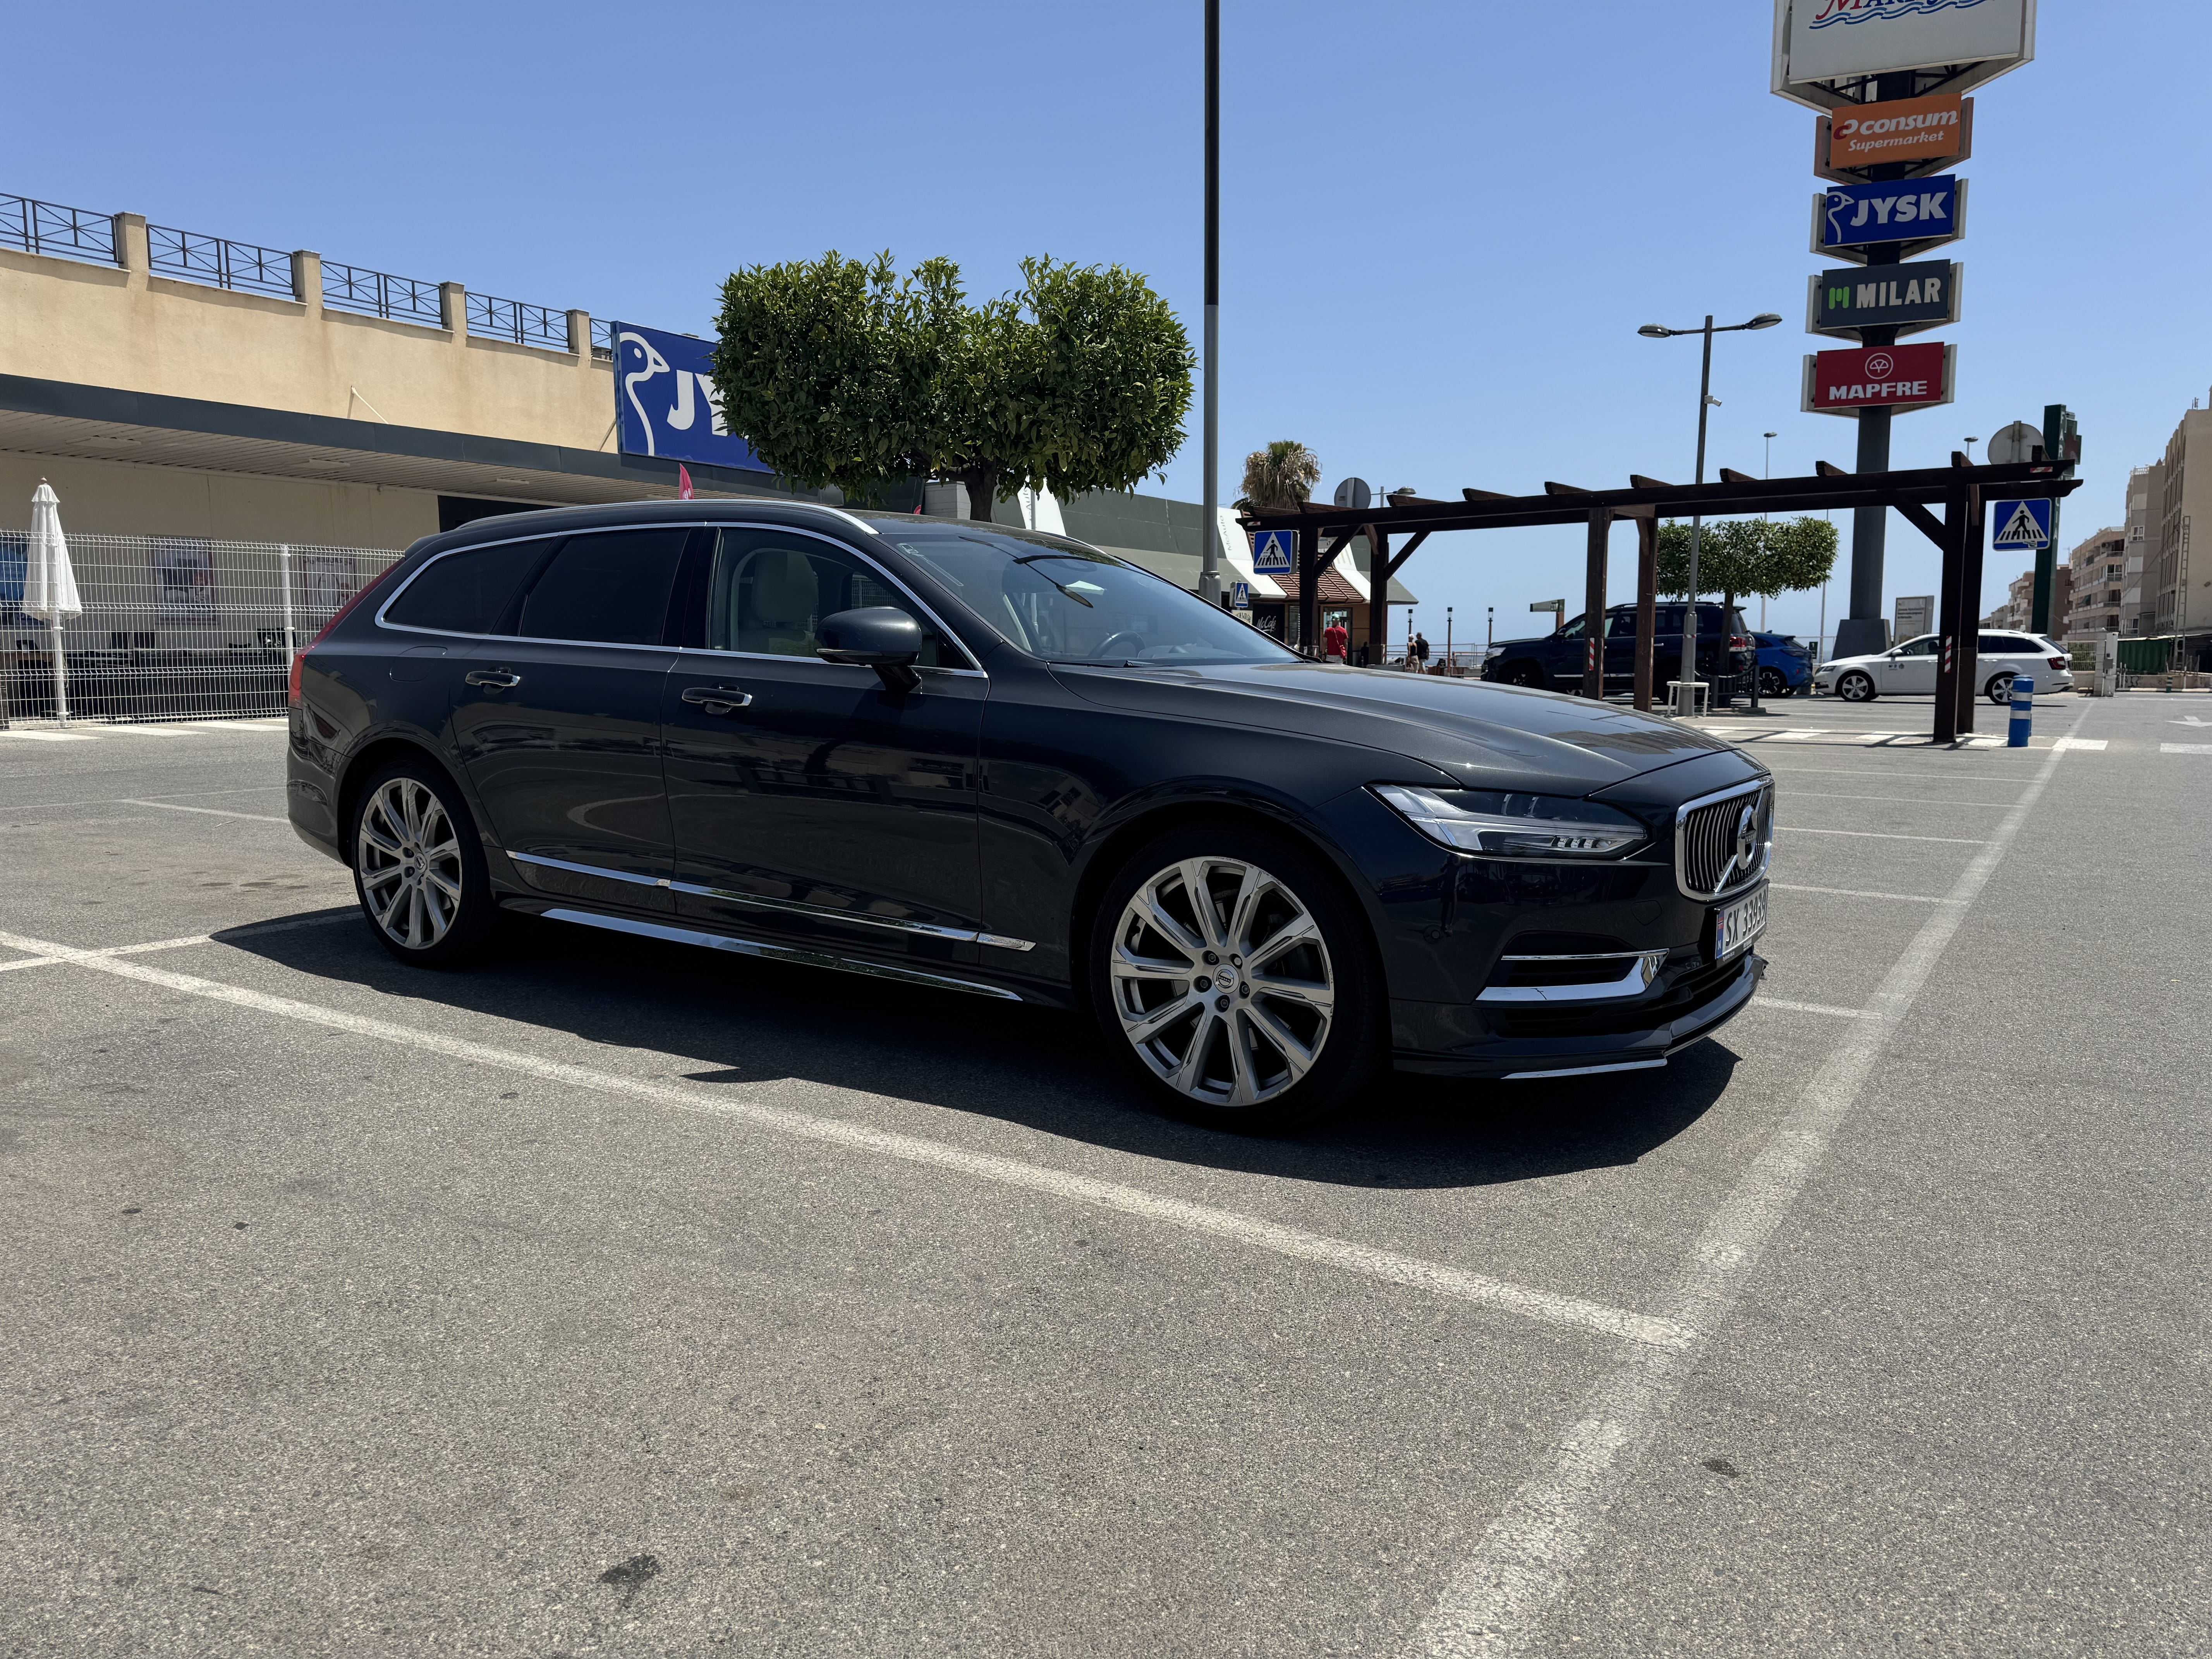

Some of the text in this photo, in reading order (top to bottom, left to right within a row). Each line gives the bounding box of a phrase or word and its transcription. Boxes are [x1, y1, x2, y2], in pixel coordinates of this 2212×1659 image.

[1860, 110, 1958, 135] consum
[1848, 130, 1944, 153] Supermarket
[1850, 191, 1948, 227] JYSK
[1856, 277, 1941, 309] MILAR
[666, 369, 750, 440] JY
[1829, 380, 1928, 400] MAPFRE
[2053, 410, 2066, 540] FARCIA
[1219, 515, 1232, 551] McAuto
[1726, 889, 1766, 946] SX 33939
[1717, 939, 1722, 950] N
